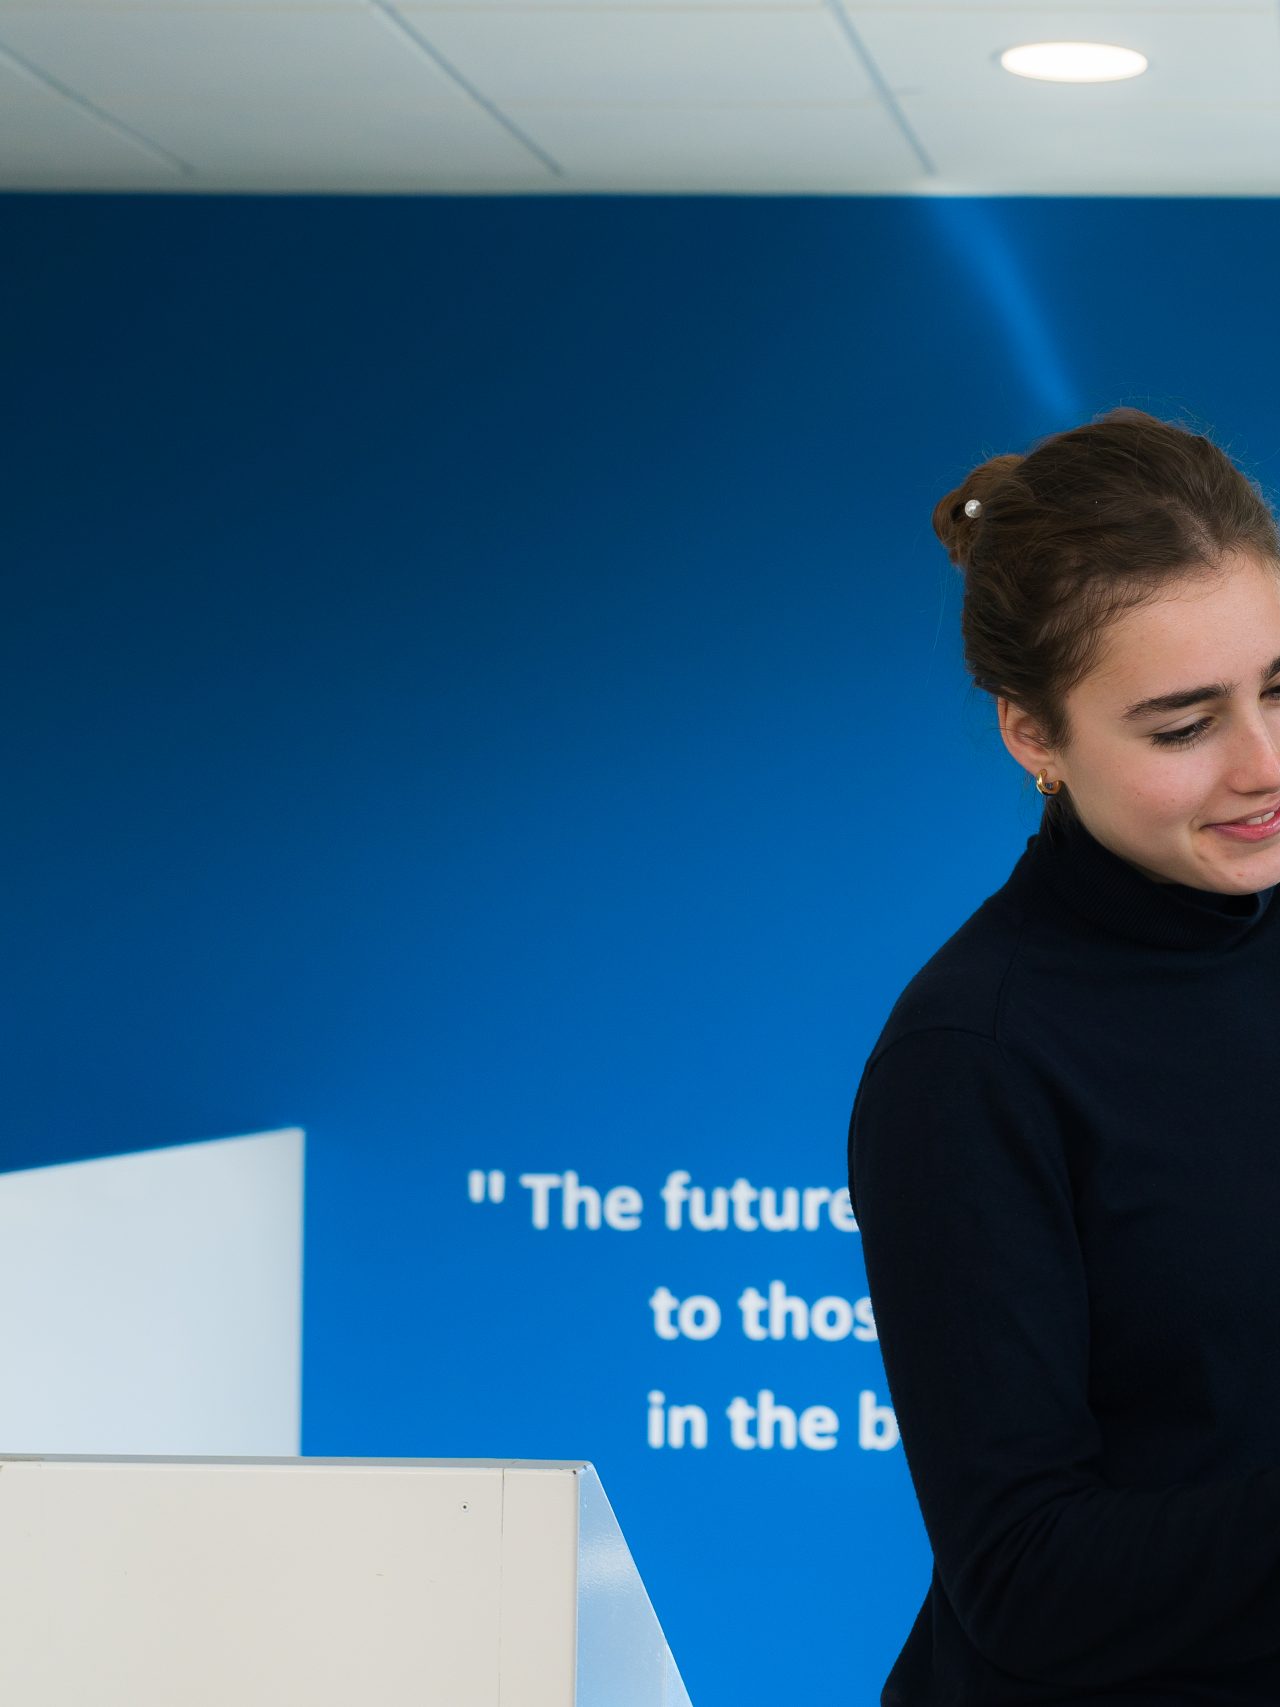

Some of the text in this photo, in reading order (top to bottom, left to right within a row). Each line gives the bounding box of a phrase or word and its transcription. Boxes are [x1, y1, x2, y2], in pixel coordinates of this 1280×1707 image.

[520, 1170, 643, 1231] The
[661, 1170, 861, 1232] future
[649, 1286, 721, 1340] to
[647, 1389, 708, 1449] in
[726, 1389, 839, 1450] the
